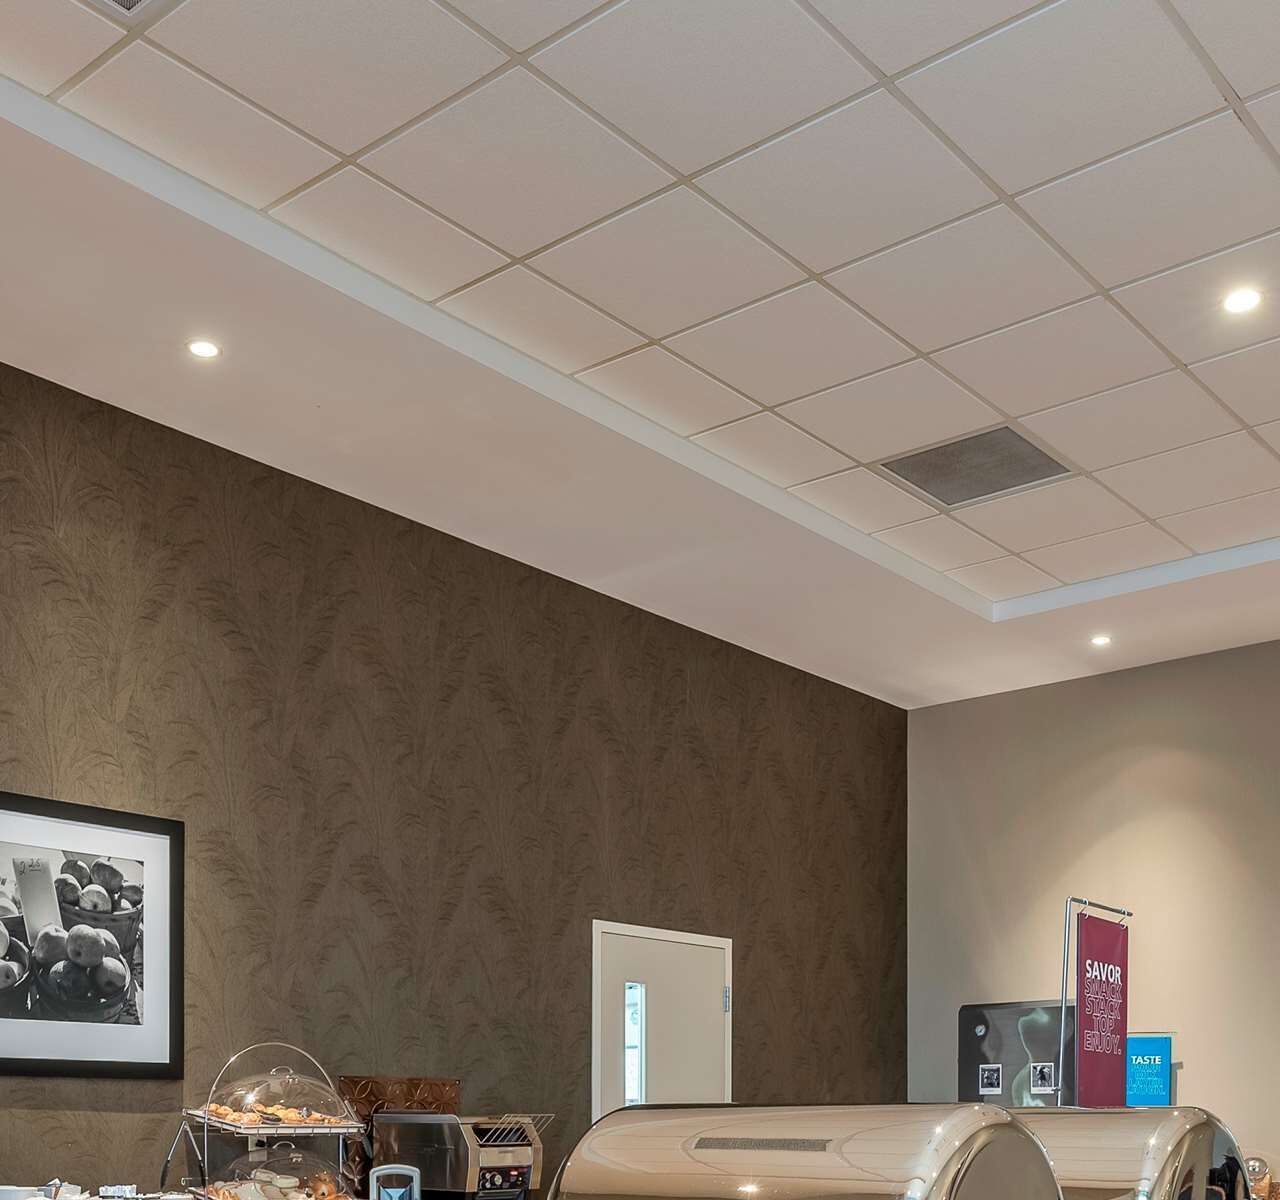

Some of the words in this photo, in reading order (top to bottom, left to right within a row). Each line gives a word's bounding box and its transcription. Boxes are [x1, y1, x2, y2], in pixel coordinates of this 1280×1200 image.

[1085, 959, 1122, 985] SAVOR
[1084, 977, 1123, 1001] SNACK
[1085, 994, 1122, 1020] STACK
[1092, 1012, 1115, 1035] TOP
[1083, 1030, 1122, 1055] ENJOY.
[1130, 1055, 1162, 1065] TASTE
